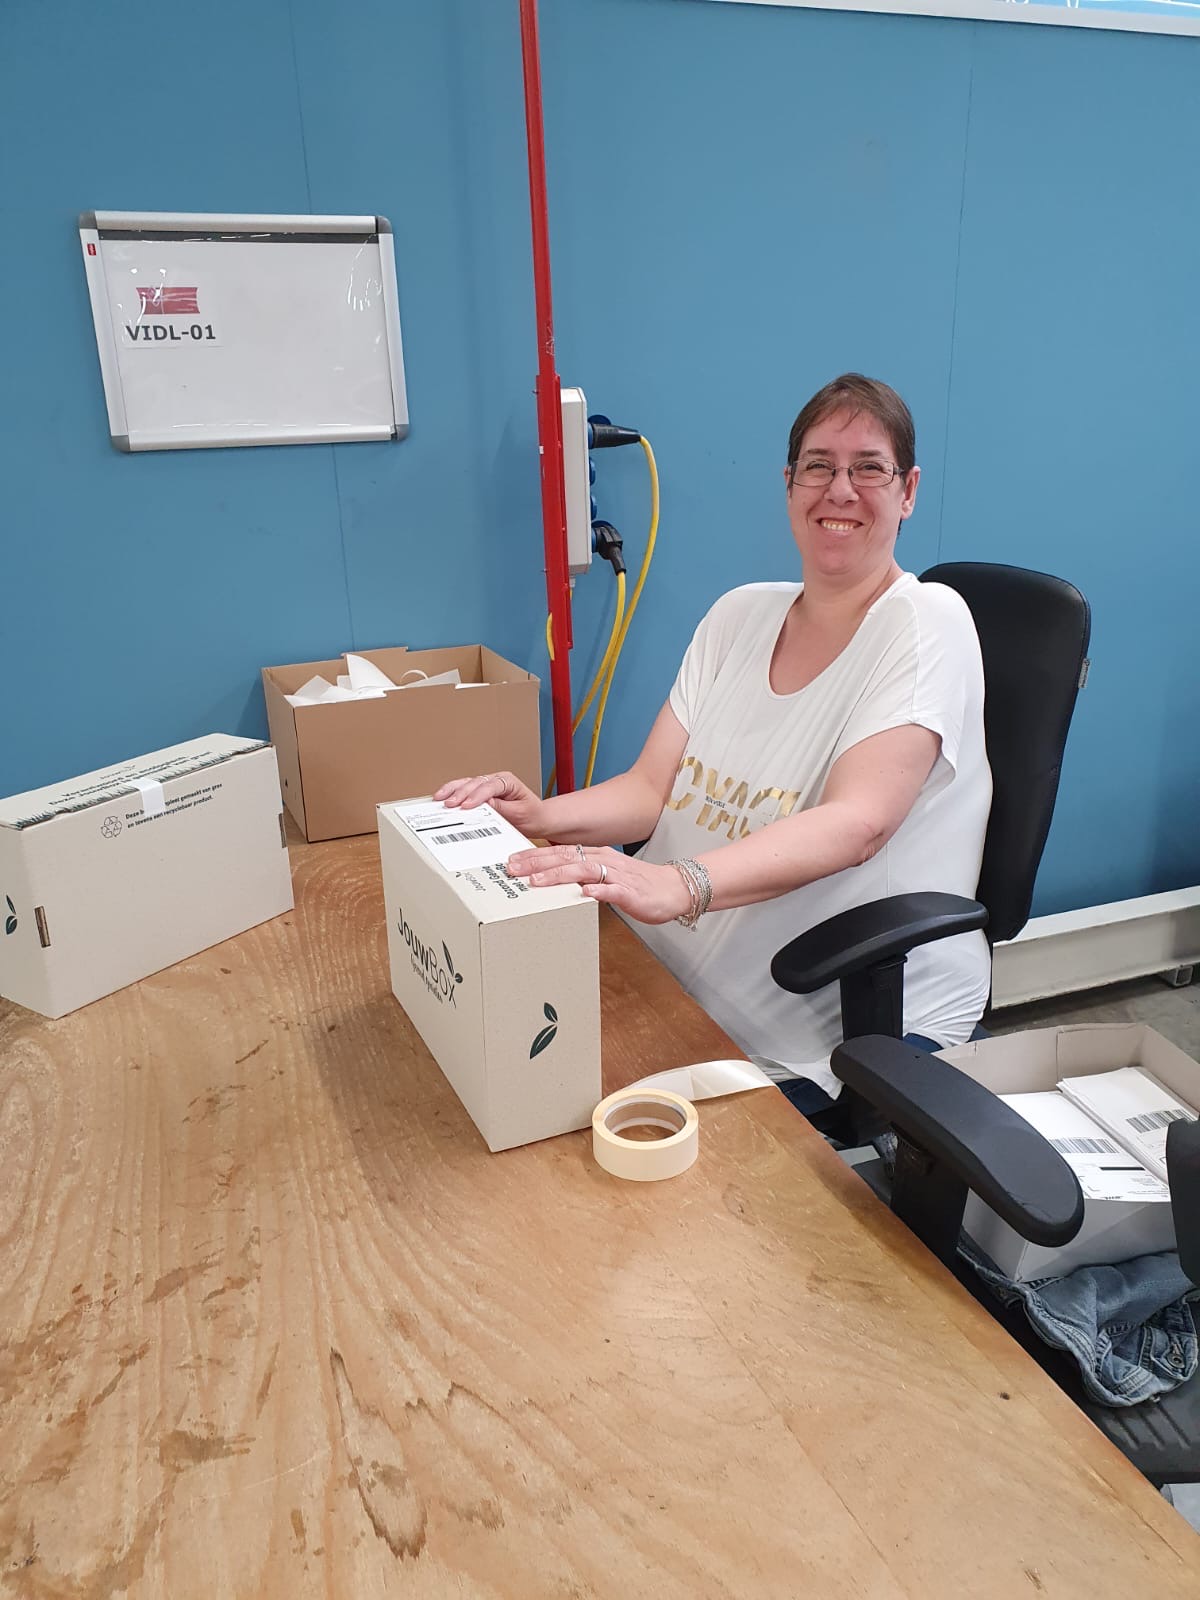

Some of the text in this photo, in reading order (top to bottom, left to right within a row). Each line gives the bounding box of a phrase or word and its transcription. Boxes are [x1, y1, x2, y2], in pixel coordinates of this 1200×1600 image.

[125, 324, 216, 341] VIDL-01
[125, 810, 140, 820] Deze
[180, 790, 202, 803] gemaakt
[493, 879, 519, 899] Gezond
